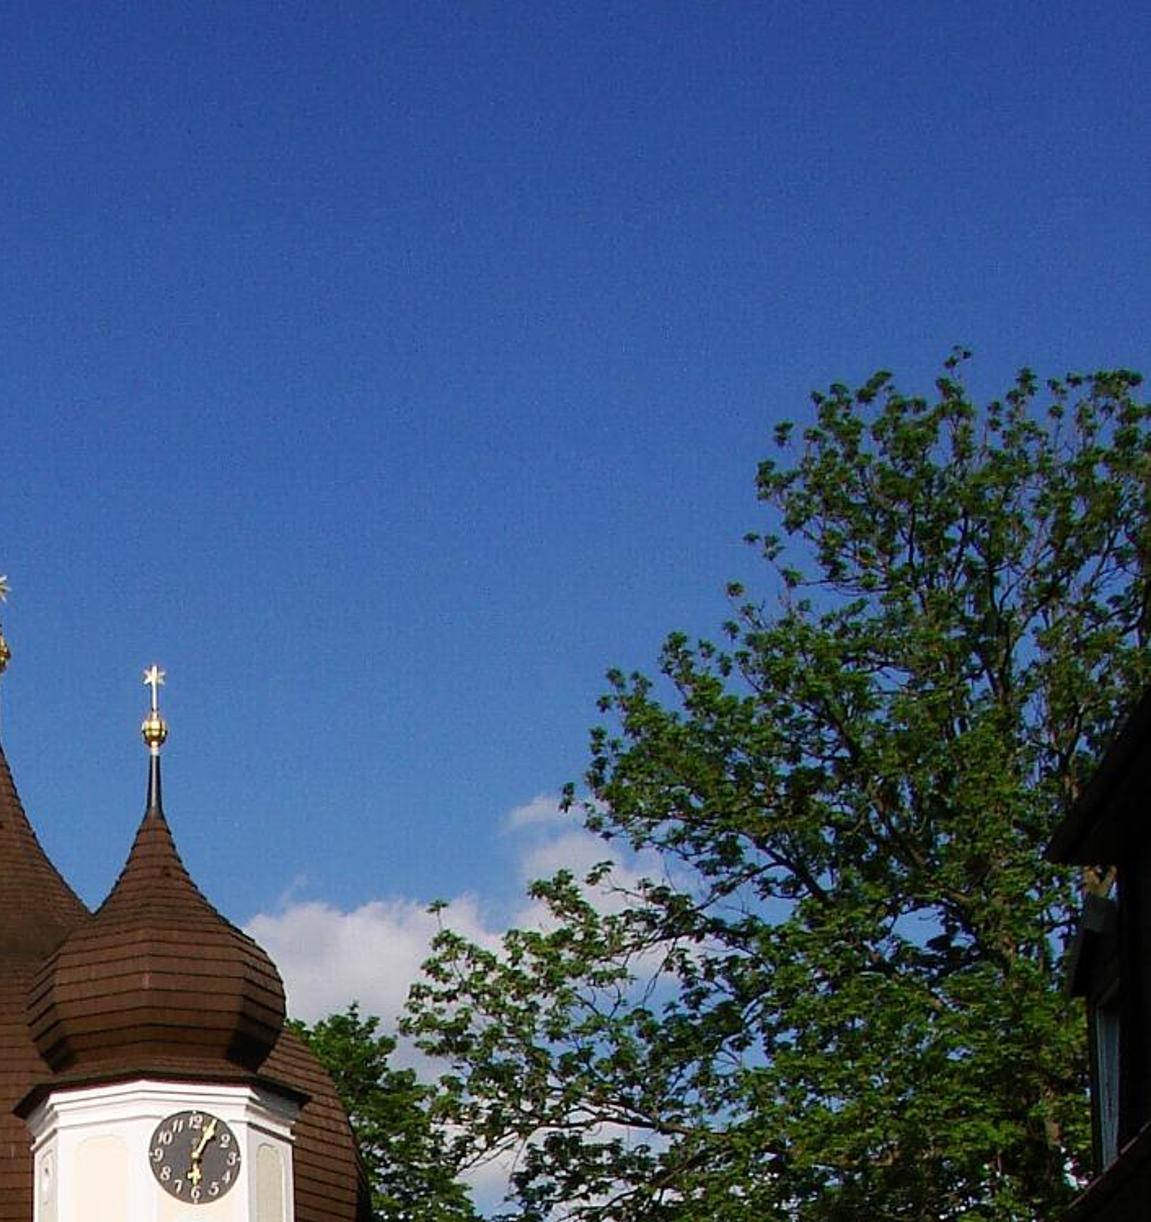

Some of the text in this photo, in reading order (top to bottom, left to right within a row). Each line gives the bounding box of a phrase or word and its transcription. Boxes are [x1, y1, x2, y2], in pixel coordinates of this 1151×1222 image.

[172, 1120, 184, 1133] 11
[189, 1114, 203, 1129] 12
[158, 1131, 173, 1145] 10
[219, 1133, 230, 1149] 2
[153, 1148, 164, 1162] 9
[227, 1152, 237, 1166] 3
[160, 1165, 171, 1180] 8
[221, 1170, 230, 1184] 4
[174, 1179, 183, 1194] 7
[190, 1185, 201, 1199] 6
[208, 1181, 219, 1196] 5
